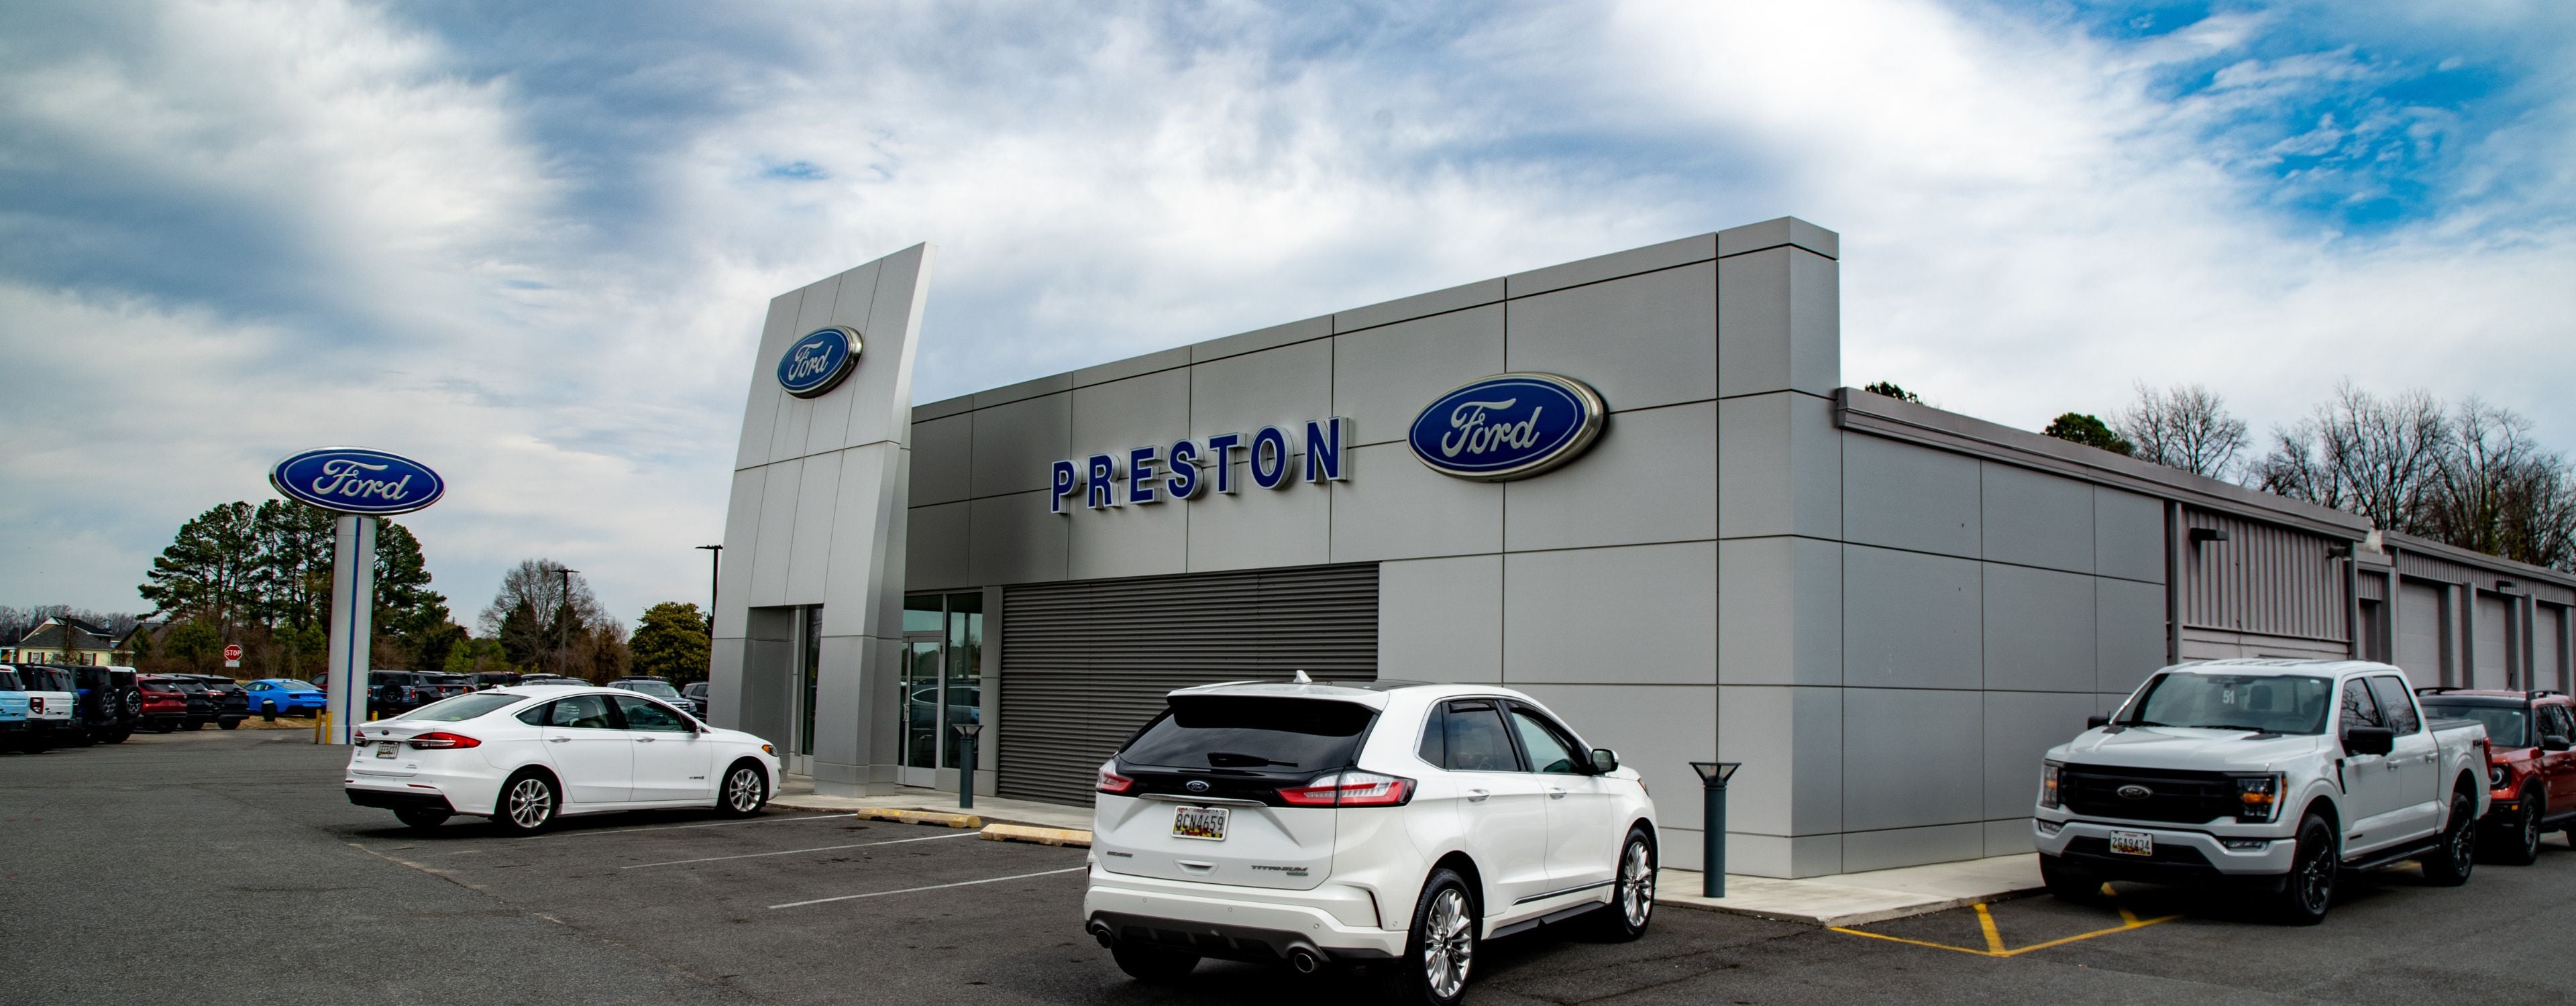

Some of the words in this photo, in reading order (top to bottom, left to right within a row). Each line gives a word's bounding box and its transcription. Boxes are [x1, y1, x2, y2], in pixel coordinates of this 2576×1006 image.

[788, 341, 833, 381] Ford
[1442, 398, 1542, 457] Ford
[312, 459, 412, 500] Ford
[1051, 416, 1347, 514] PRESTON
[1175, 814, 1224, 832] 8CN4659
